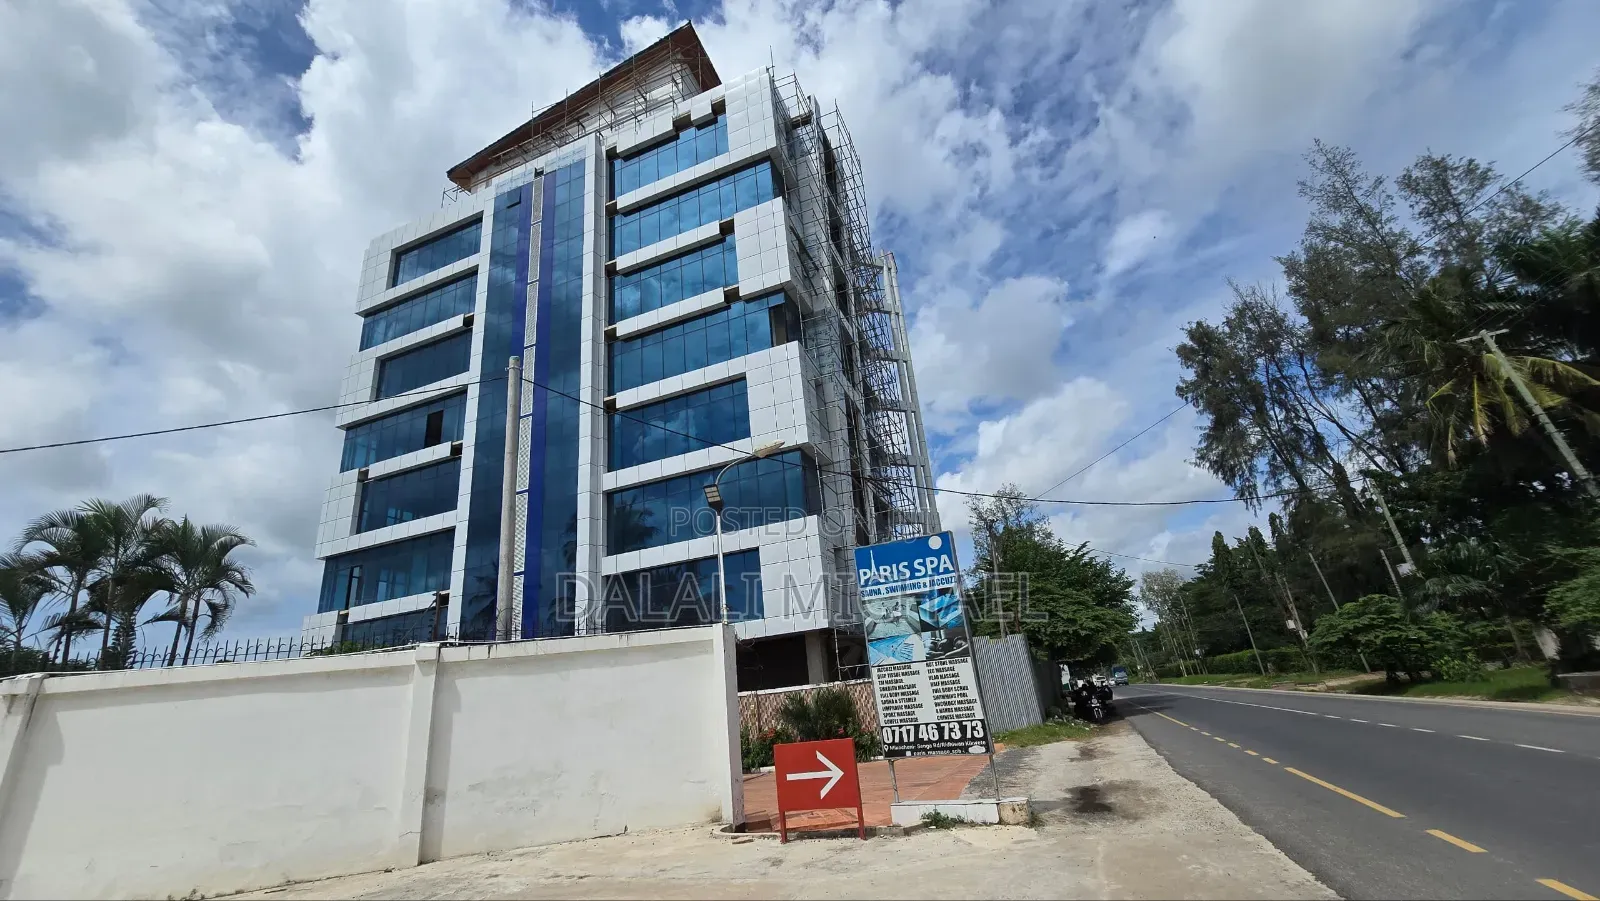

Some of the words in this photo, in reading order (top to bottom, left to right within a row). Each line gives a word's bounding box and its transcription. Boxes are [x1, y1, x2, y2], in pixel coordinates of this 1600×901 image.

[859, 549, 910, 586] PARIS
[913, 553, 955, 577] SPA
[883, 726, 914, 744] 0717
[919, 724, 939, 741] 46
[941, 722, 962, 739] 73
[963, 720, 984, 738] 73
